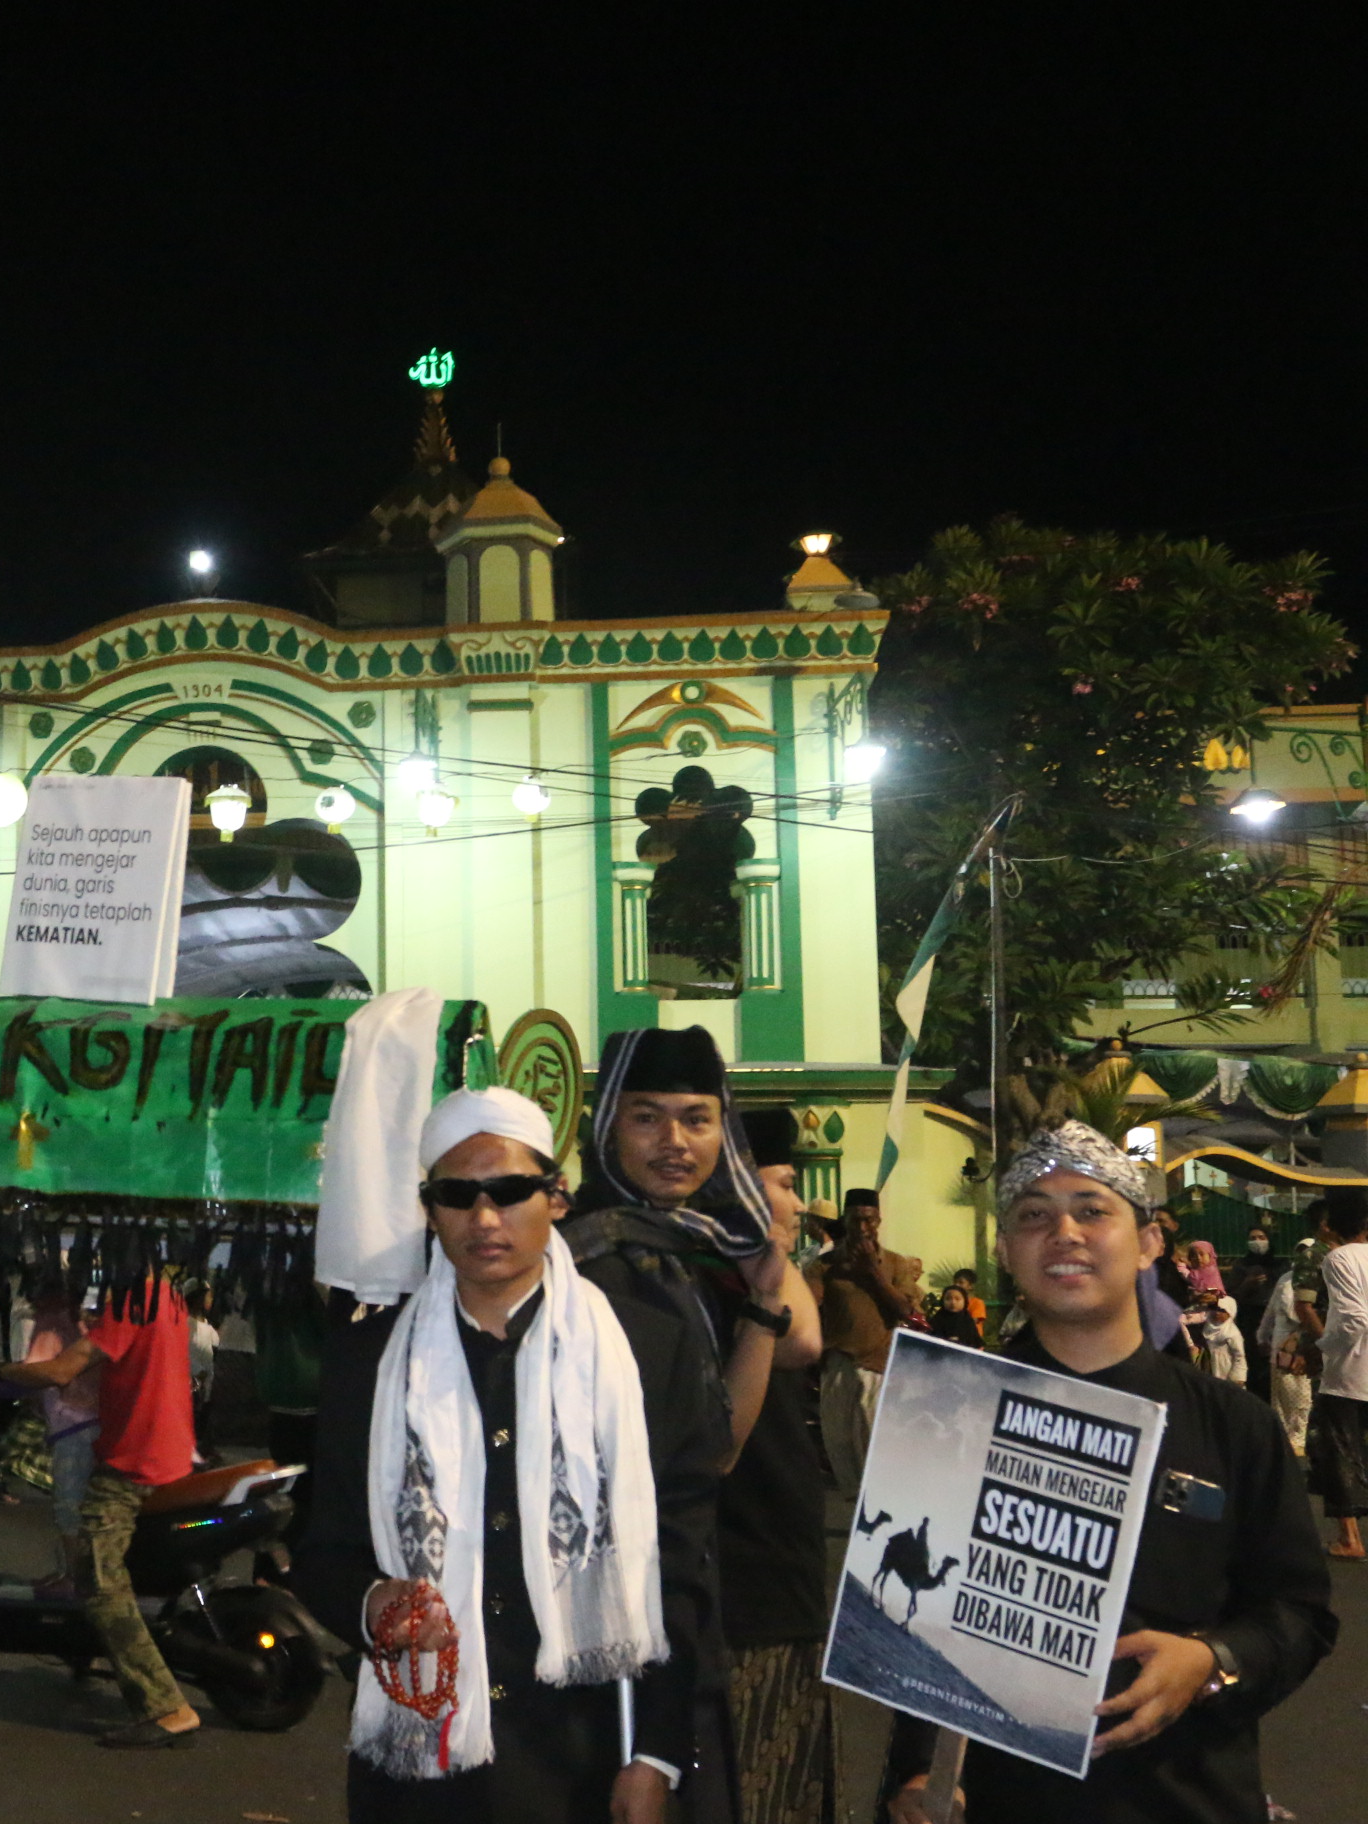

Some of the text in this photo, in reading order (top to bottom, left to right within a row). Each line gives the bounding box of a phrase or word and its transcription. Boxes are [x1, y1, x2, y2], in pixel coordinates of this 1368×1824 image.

[31, 824, 152, 848] Sejauh apapun
[26, 849, 137, 874] kita mengejar
[23, 873, 115, 899] dunia, garis
[19, 899, 152, 923] finisnya tetaplah
[15, 925, 103, 946] KEMATIAN.
[999, 1401, 1134, 1466] JANGAN MATI
[985, 1449, 1128, 1515] MATIAN MENGEJAR
[979, 1488, 1114, 1571] SESUATU
[967, 1543, 1107, 1623] YANG TIDAK
[952, 1591, 1097, 1670] DIBAWA MATI
